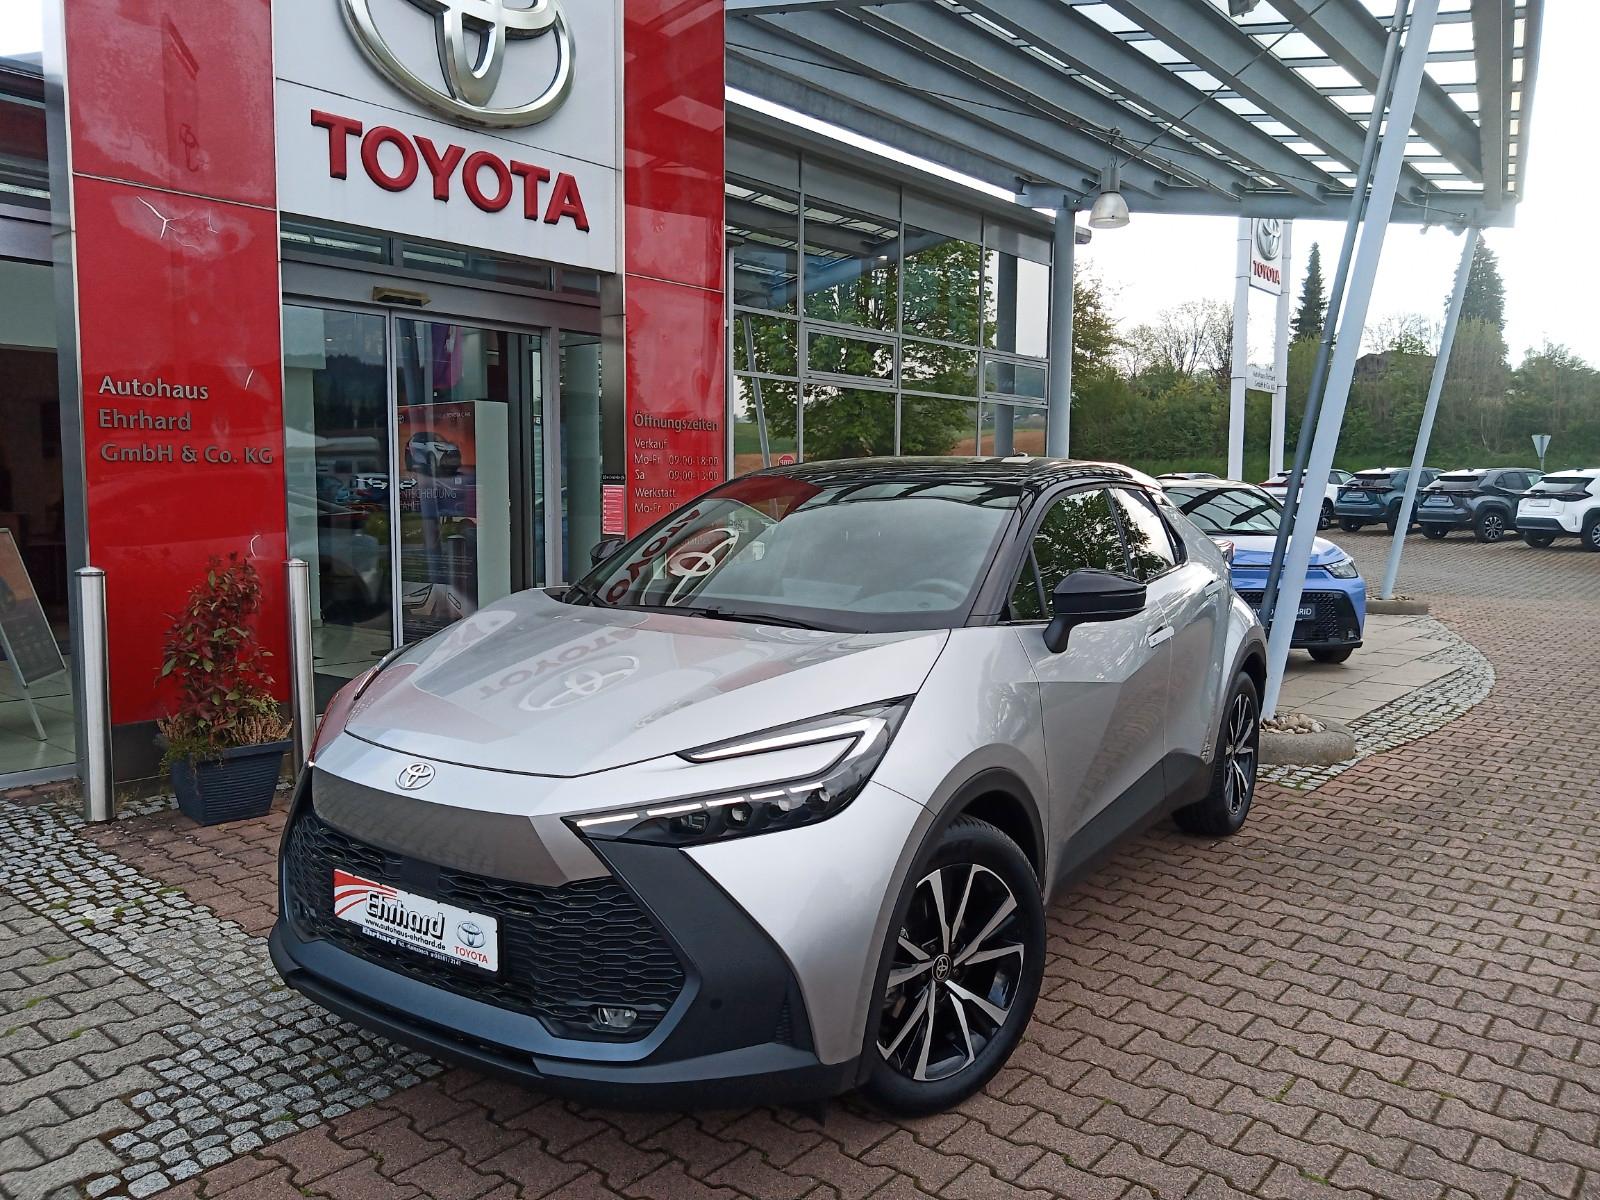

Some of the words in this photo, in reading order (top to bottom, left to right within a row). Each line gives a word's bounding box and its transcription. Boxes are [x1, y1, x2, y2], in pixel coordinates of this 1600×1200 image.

[311, 109, 590, 233] TOYOTA
[1252, 260, 1280, 284] TOYOTA
[98, 375, 209, 400] Autohaus
[98, 408, 192, 430] Ehrhard
[634, 411, 719, 432] Öffnungszeiten
[101, 443, 173, 462] GmbH
[181, 445, 198, 463] &
[205, 446, 238, 463] Co.
[245, 447, 273, 464] KG
[634, 438, 668, 449] Verkauf
[634, 454, 661, 465] Mo-Fr
[634, 469, 645, 480] Sa
[635, 487, 676, 498] Werkstatt
[634, 502, 661, 513] Mo-Fr
[366, 891, 445, 940] Ehrhard
[362, 926, 397, 946] Ehrhard
[365, 918, 446, 951] www.autohaus-ehrhard.de
[454, 946, 488, 964] TOYOTA
